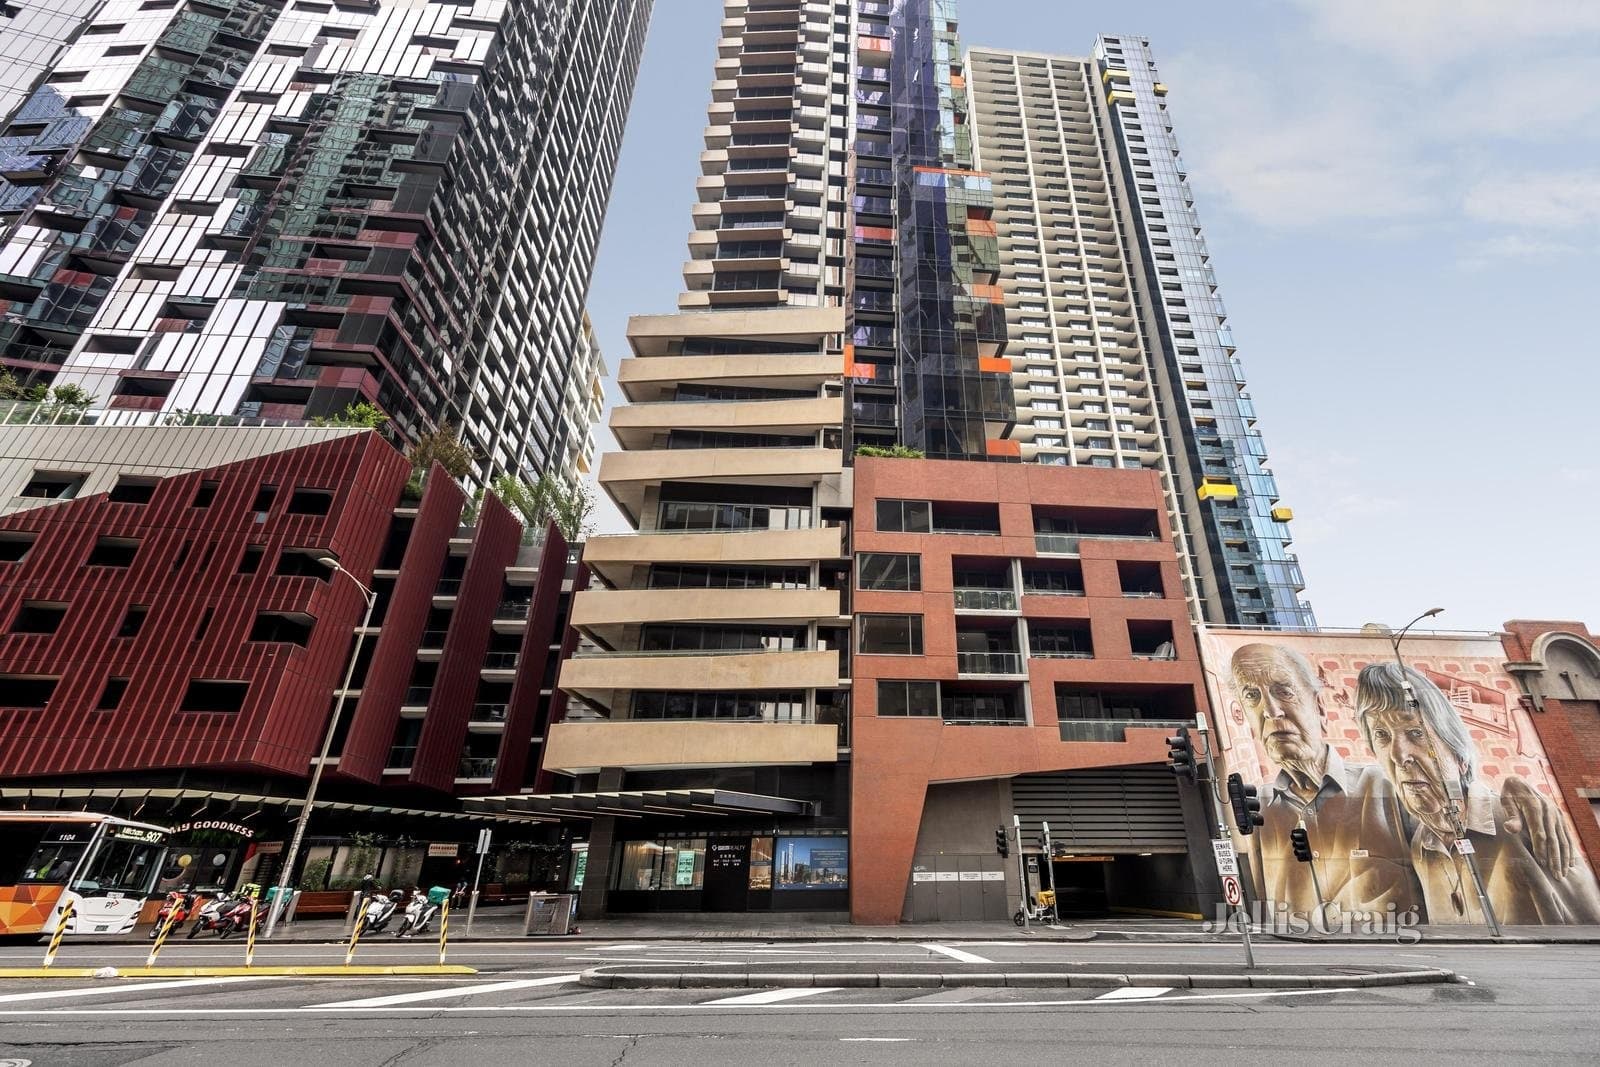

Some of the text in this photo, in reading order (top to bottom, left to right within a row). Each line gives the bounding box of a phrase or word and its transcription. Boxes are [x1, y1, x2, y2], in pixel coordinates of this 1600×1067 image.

[193, 821, 254, 838] GOODNESS
[146, 831, 163, 844] 907
[1219, 857, 1233, 865] U-TURN
